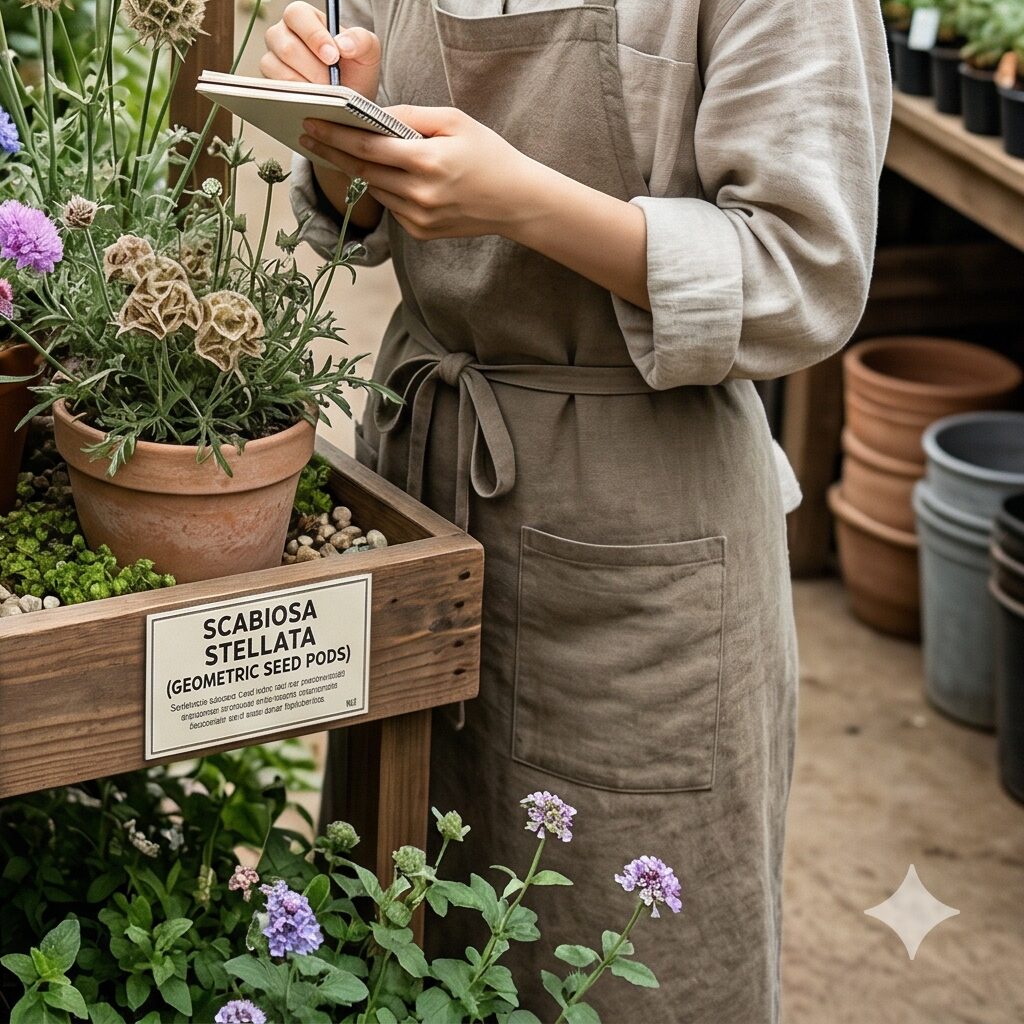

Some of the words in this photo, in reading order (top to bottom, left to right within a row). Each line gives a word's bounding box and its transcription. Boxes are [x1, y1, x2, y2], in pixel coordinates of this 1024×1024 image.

[203, 599, 317, 640] SCABIOSA
[205, 626, 316, 666] STELLATA
[166, 664, 259, 699] (GEOMETRIC
[263, 655, 301, 676] SEED
[306, 645, 351, 668] PODS)
